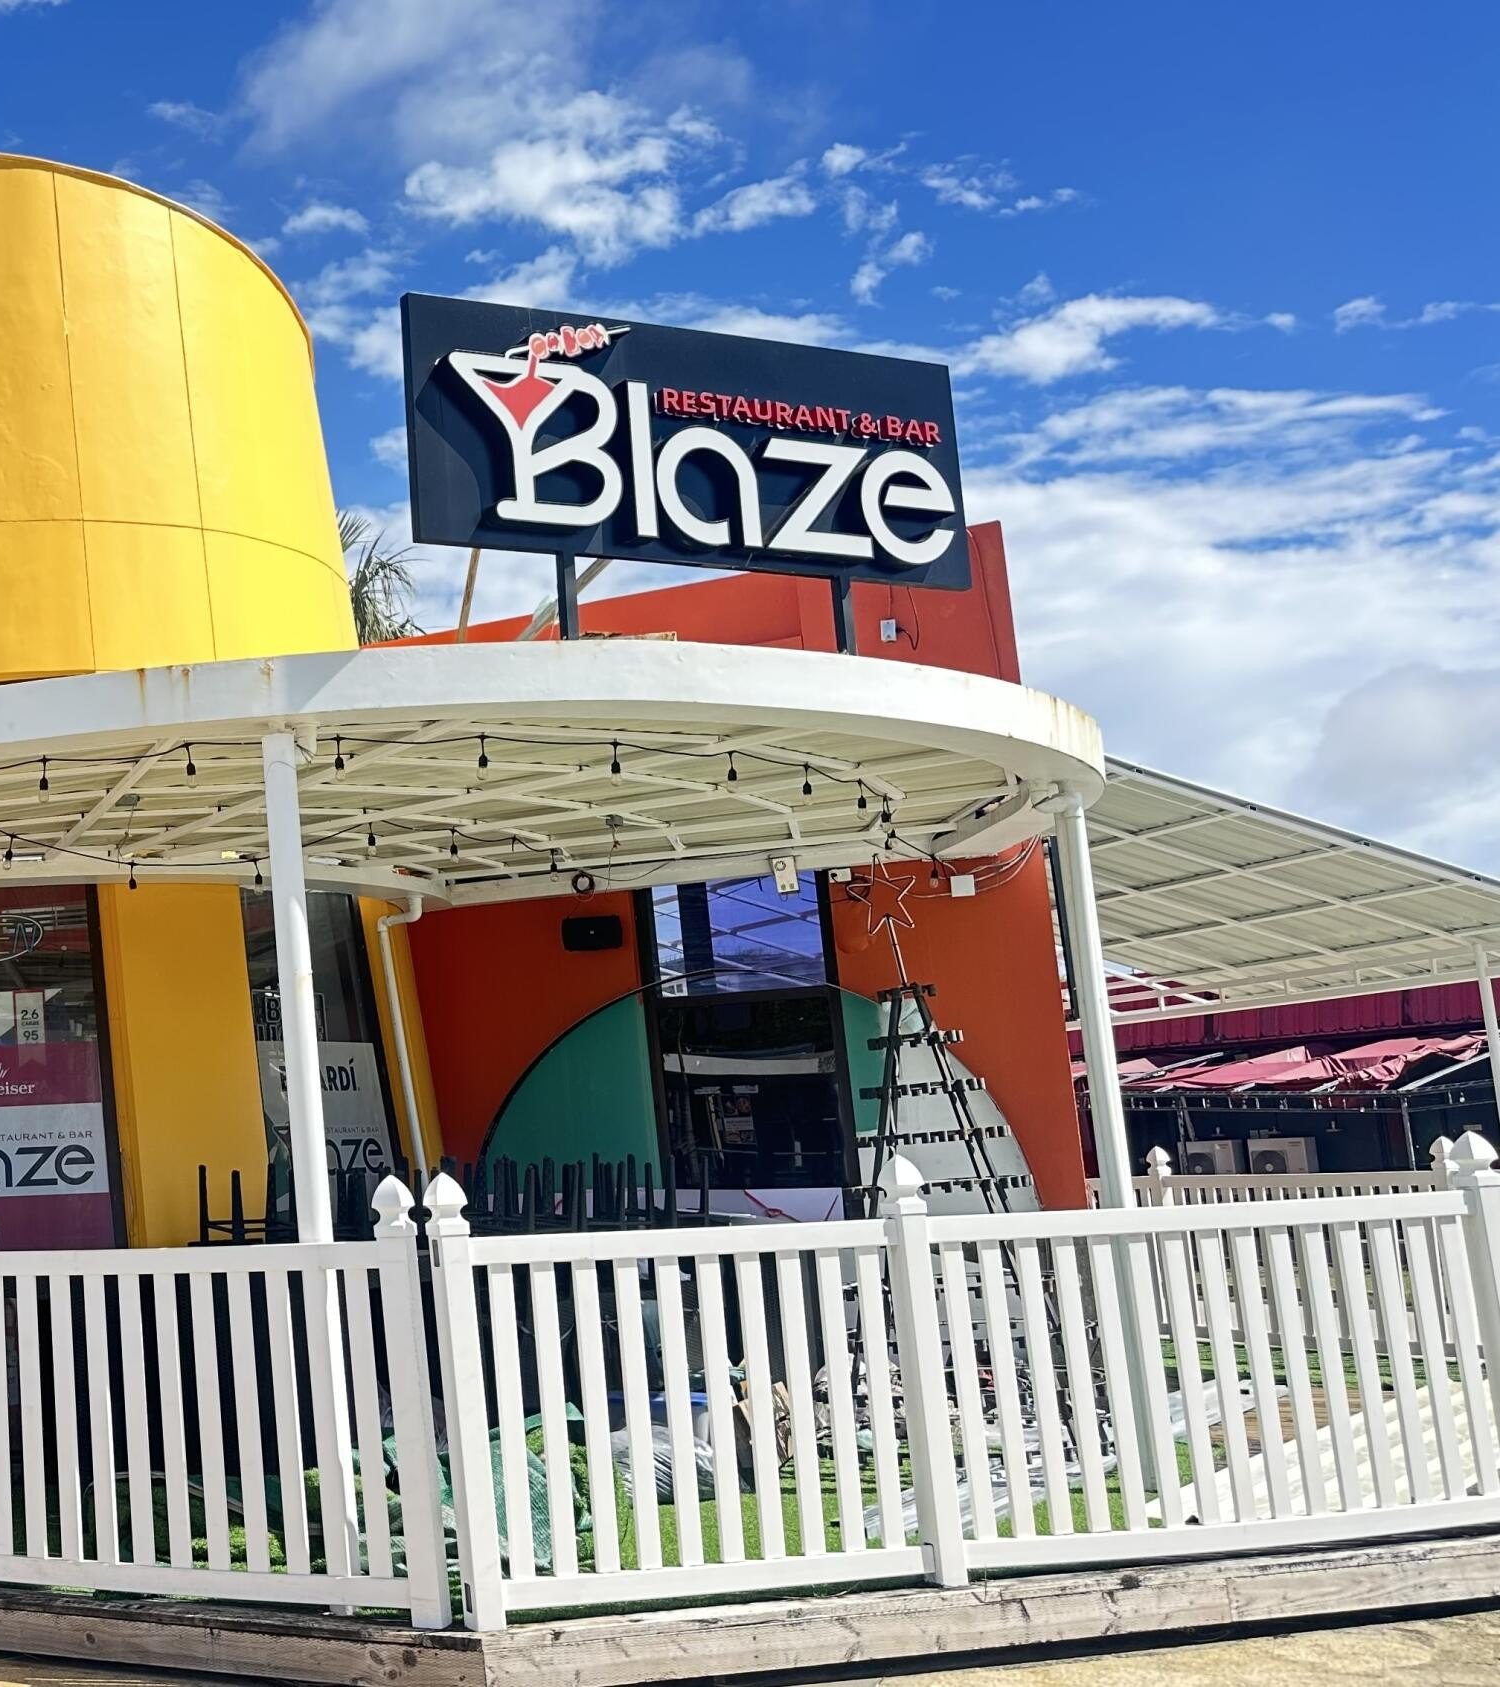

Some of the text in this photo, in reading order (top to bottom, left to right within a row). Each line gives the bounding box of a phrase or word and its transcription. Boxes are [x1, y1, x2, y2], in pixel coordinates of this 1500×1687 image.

[656, 387, 943, 446] RESTAURANT & BAR
[449, 350, 956, 565] Blaze
[23, 1030, 39, 1041] 95
[57, 1131, 66, 1139] &
[69, 1130, 93, 1139] BAR
